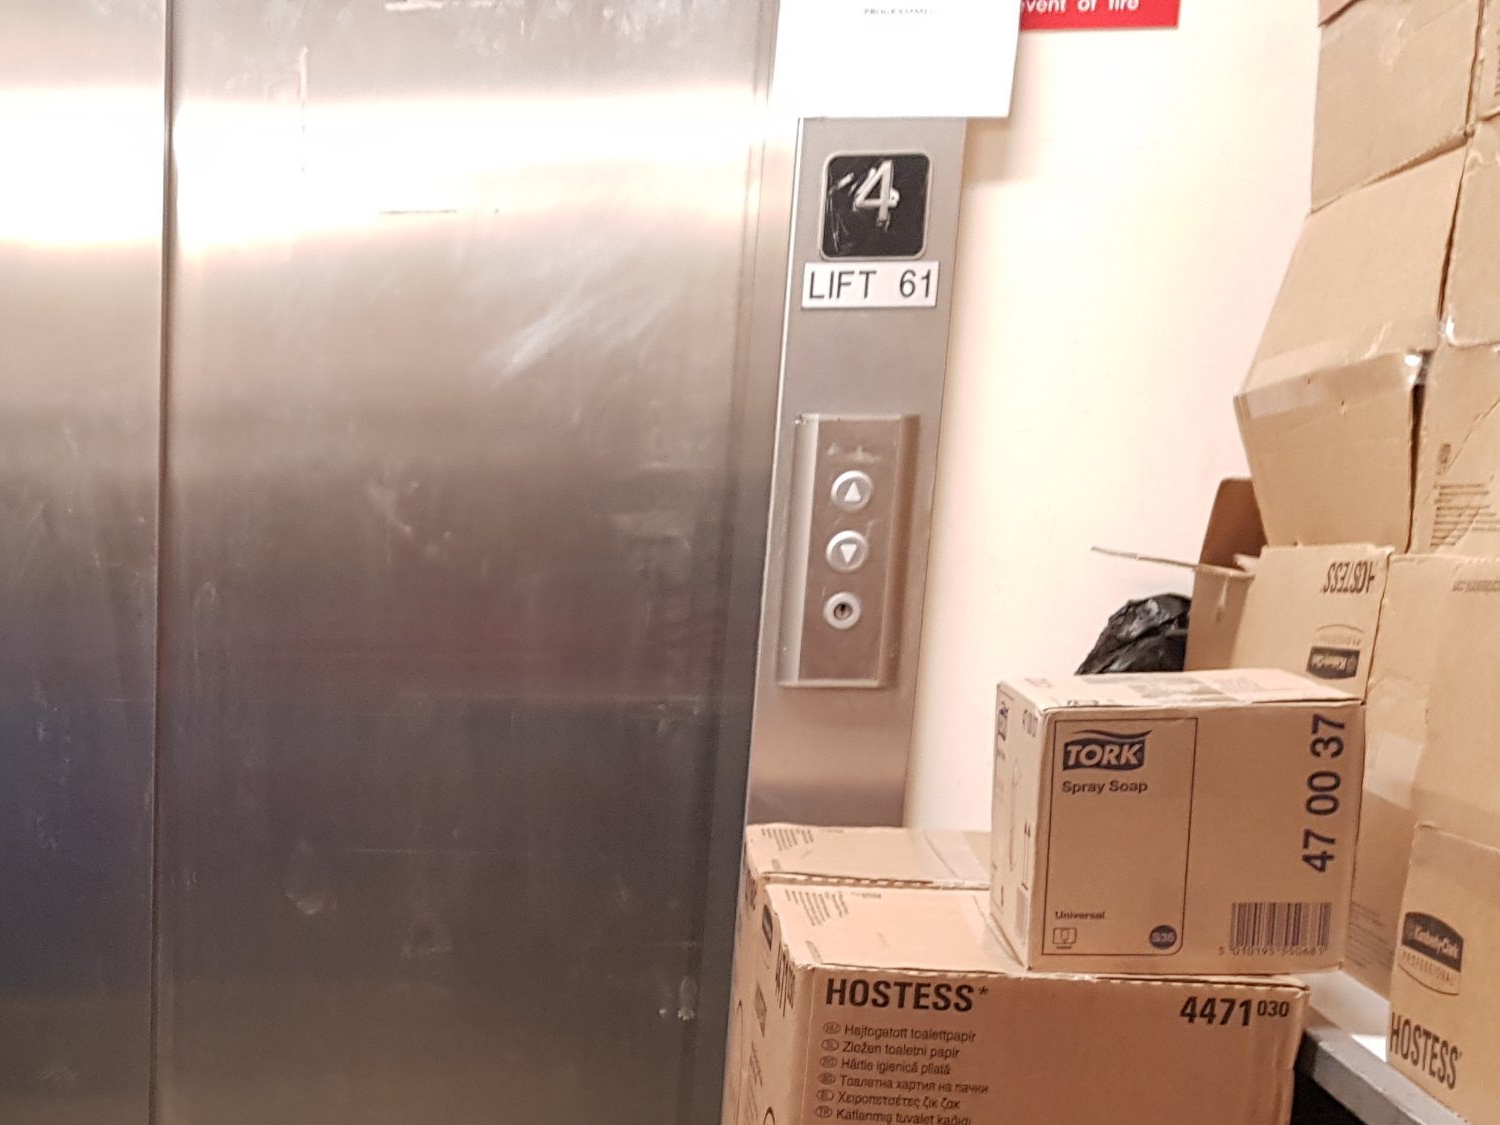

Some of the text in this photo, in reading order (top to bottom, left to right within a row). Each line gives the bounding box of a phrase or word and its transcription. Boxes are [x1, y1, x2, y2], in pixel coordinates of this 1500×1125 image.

[1022, 0, 1066, 12] vent
[855, 160, 900, 224] 4
[809, 269, 931, 299] LIFT 61
[1310, 713, 1346, 759] 37
[1066, 744, 1143, 766] TORK
[1062, 780, 1149, 795] Spray Soap
[1305, 770, 1342, 816] 00
[1302, 829, 1337, 873] 47
[1055, 911, 1106, 920] Universal
[1180, 996, 1290, 1026] 4471 030
[938, 1082, 952, 1093] на
[896, 1112, 934, 1124] tuvalet
